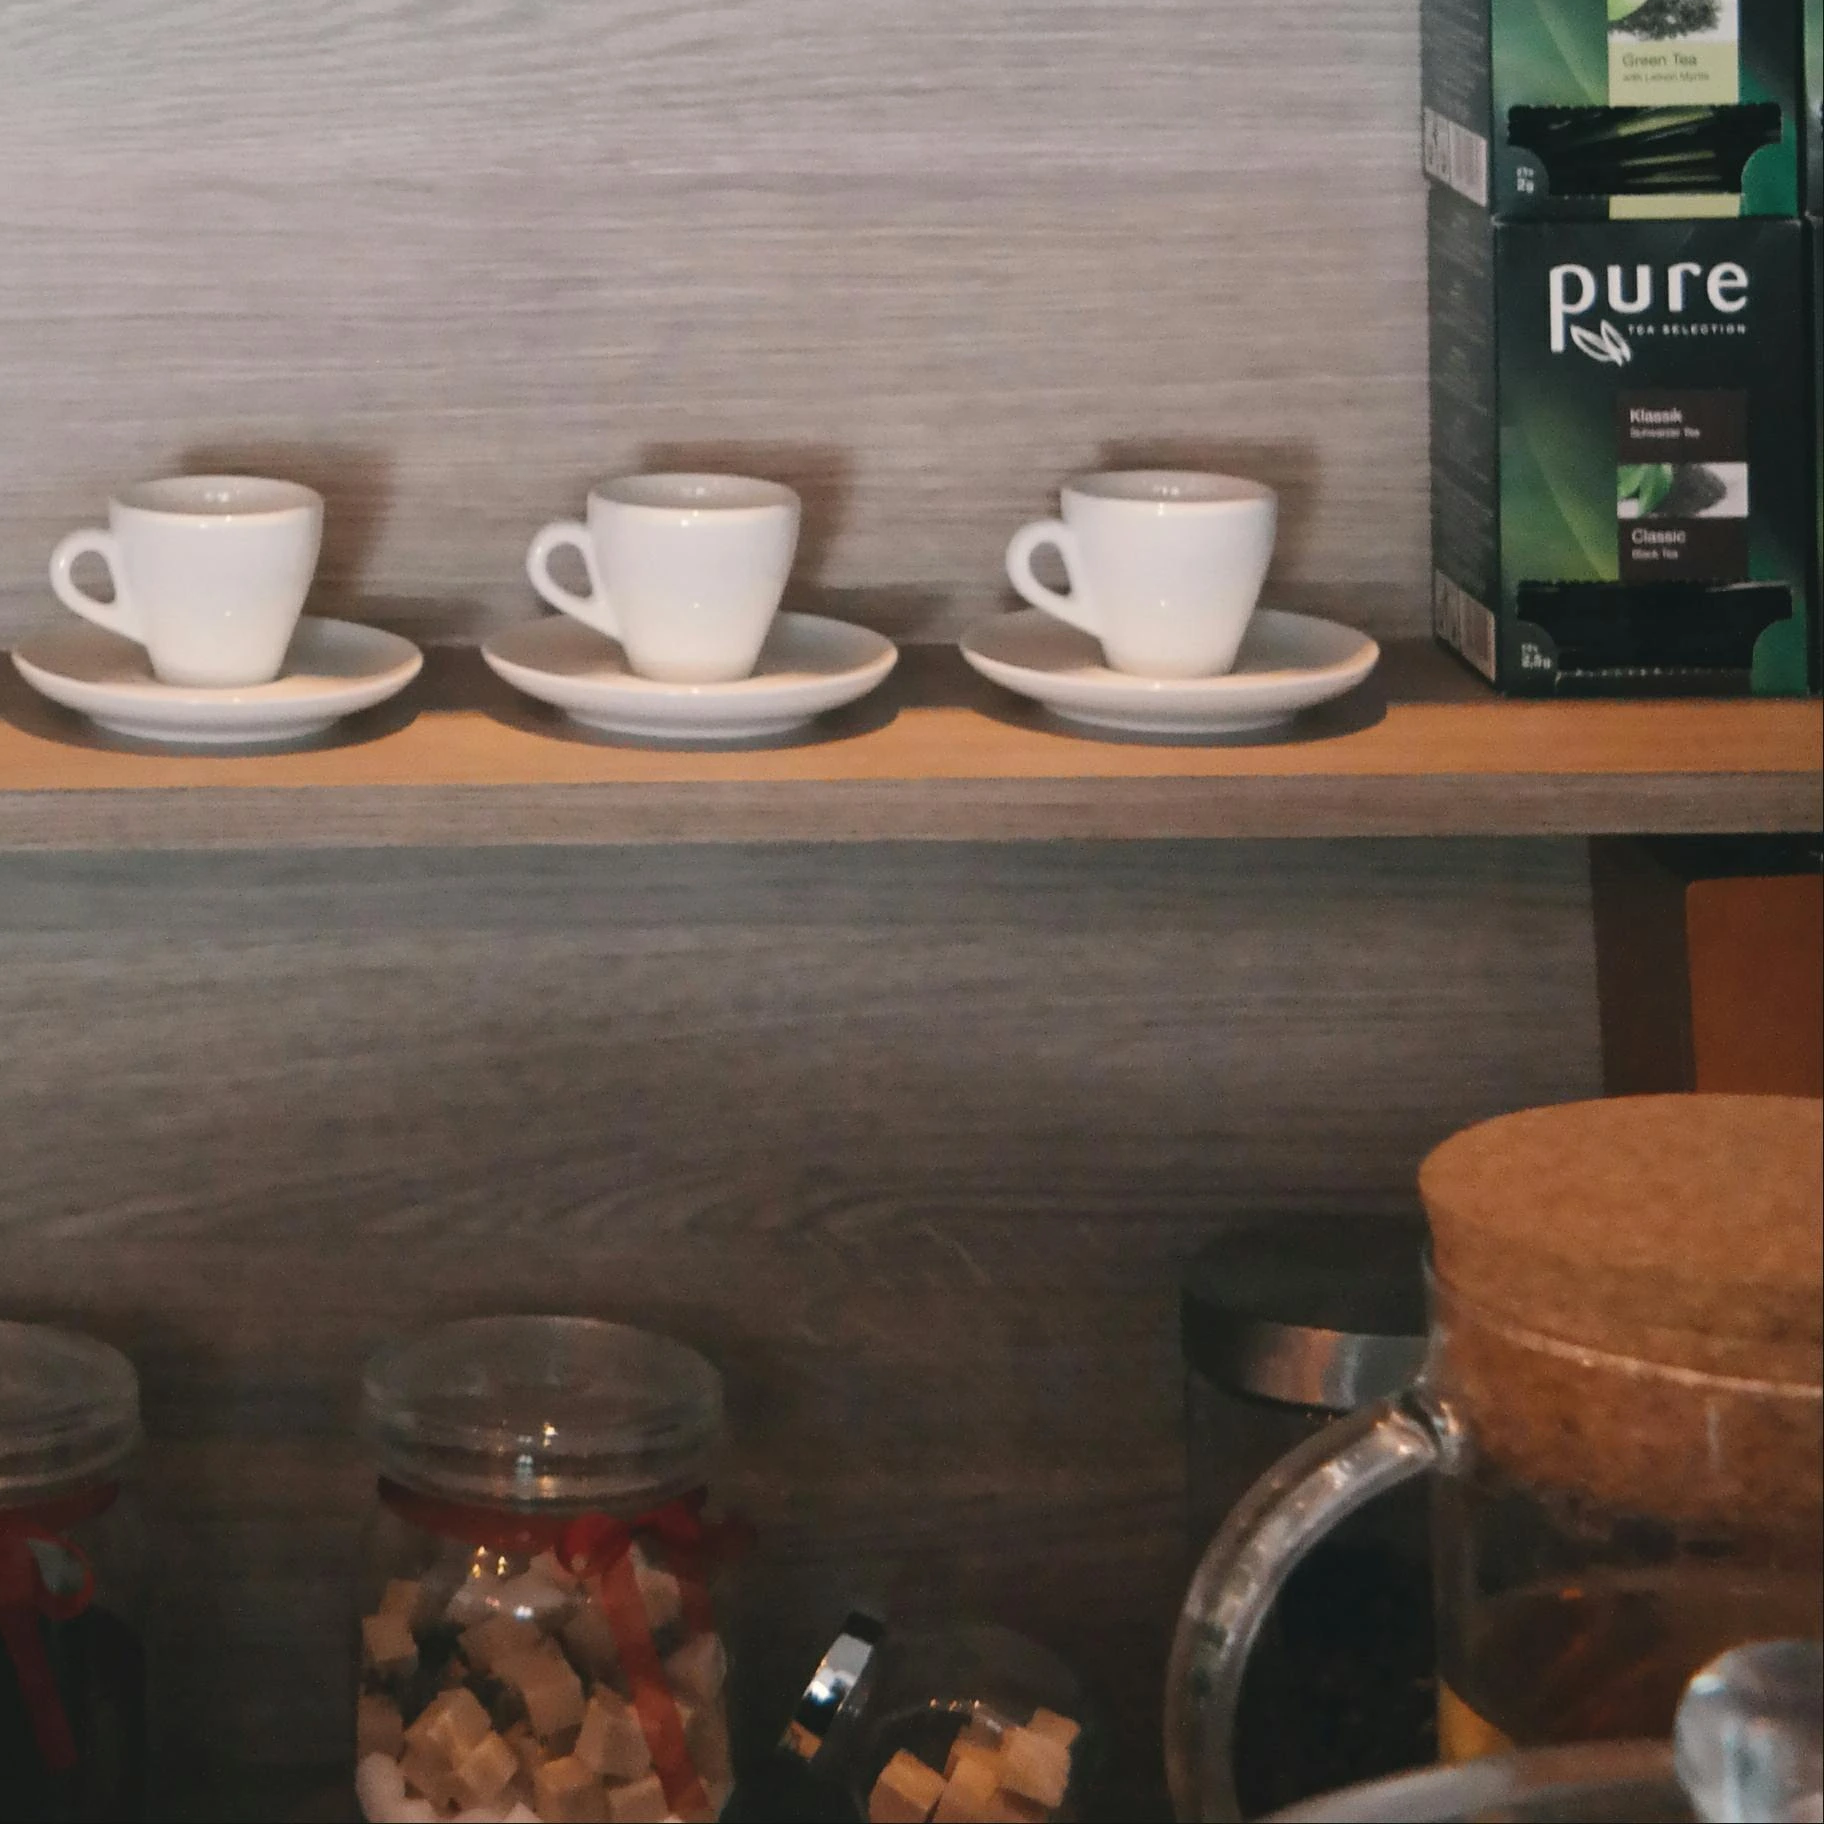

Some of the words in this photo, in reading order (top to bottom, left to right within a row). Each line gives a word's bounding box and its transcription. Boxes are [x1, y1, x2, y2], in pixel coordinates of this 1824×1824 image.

[1622, 53, 1667, 67] Green
[1673, 52, 1698, 66] Tea
[1549, 261, 1749, 353] pure
[1628, 323, 1655, 335] TEA
[1662, 323, 1746, 336] SELECTION
[1630, 407, 1683, 424] Klassik
[1631, 527, 1687, 545] Classic
